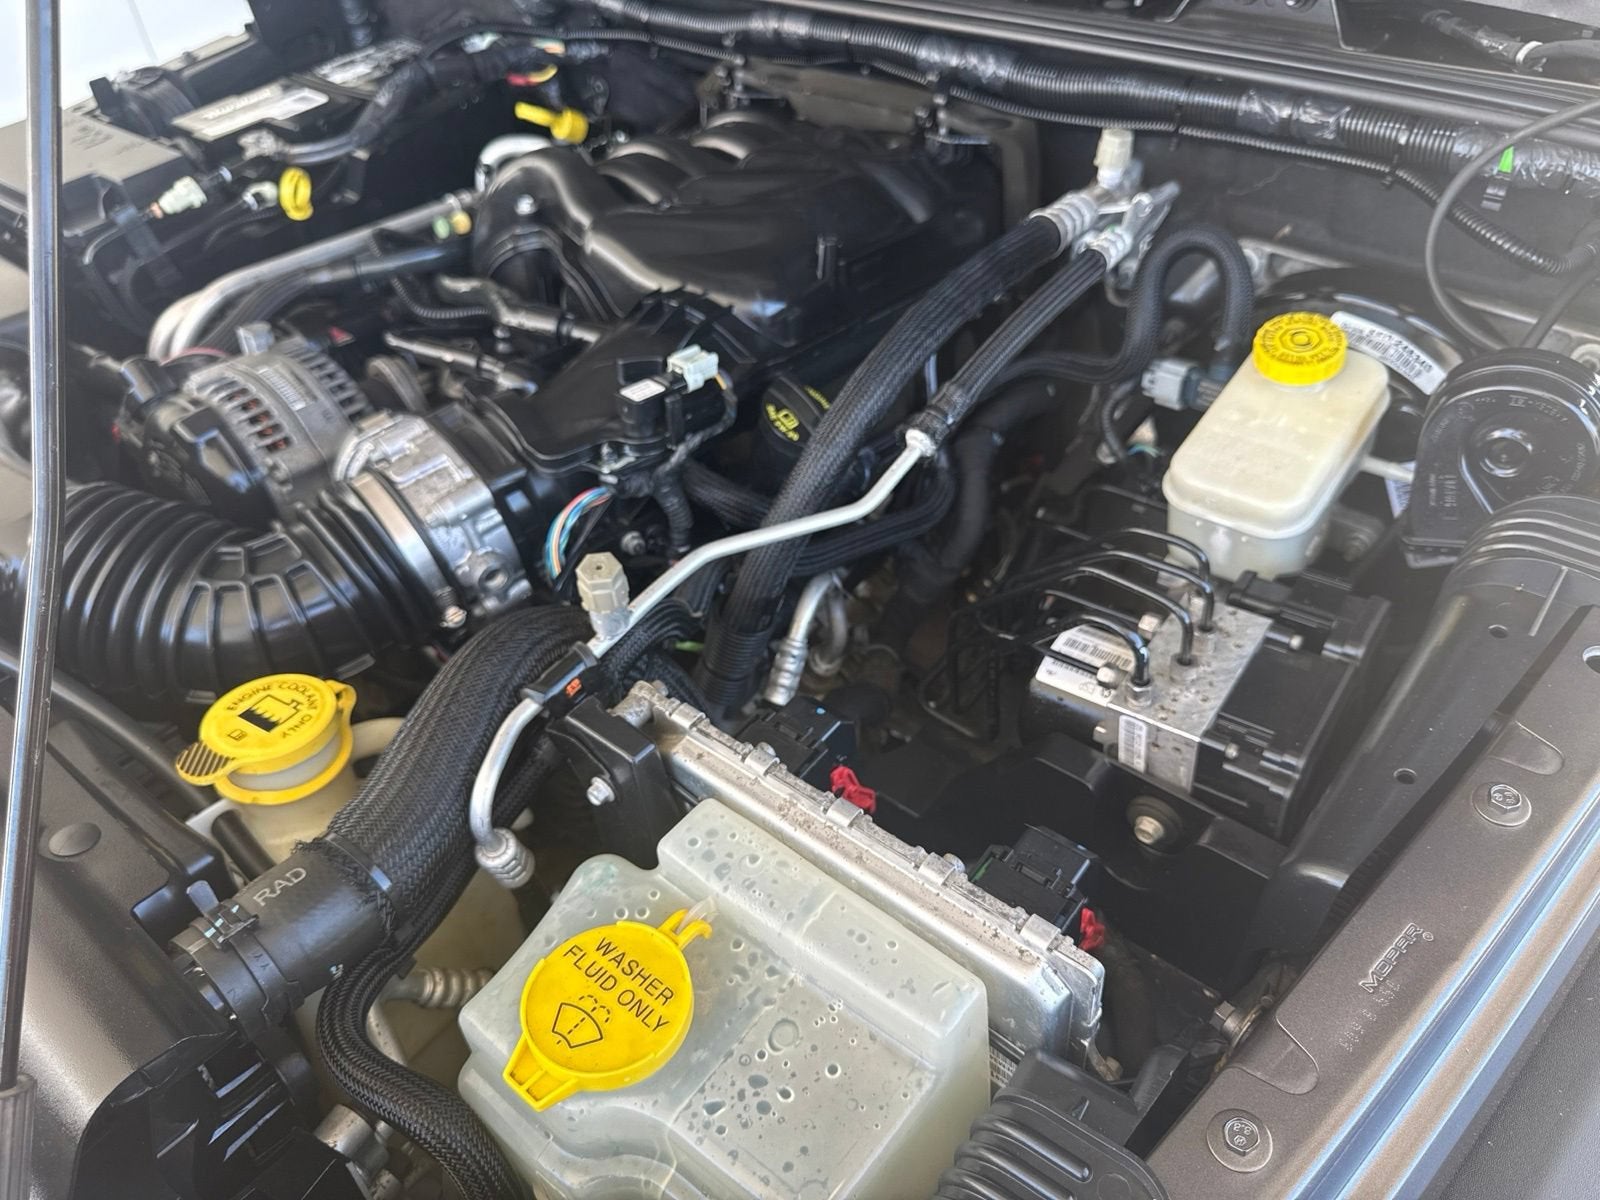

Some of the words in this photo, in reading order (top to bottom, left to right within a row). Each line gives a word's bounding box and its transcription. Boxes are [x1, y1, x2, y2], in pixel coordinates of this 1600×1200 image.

[226, 684, 271, 711] ENGINE
[282, 713, 313, 738] ONLY
[253, 867, 307, 907] RAD
[563, 944, 618, 991] FLUID
[617, 989, 670, 1032] ONLY
[595, 937, 674, 1006] WASHER
[1359, 922, 1424, 993] MOPAR
